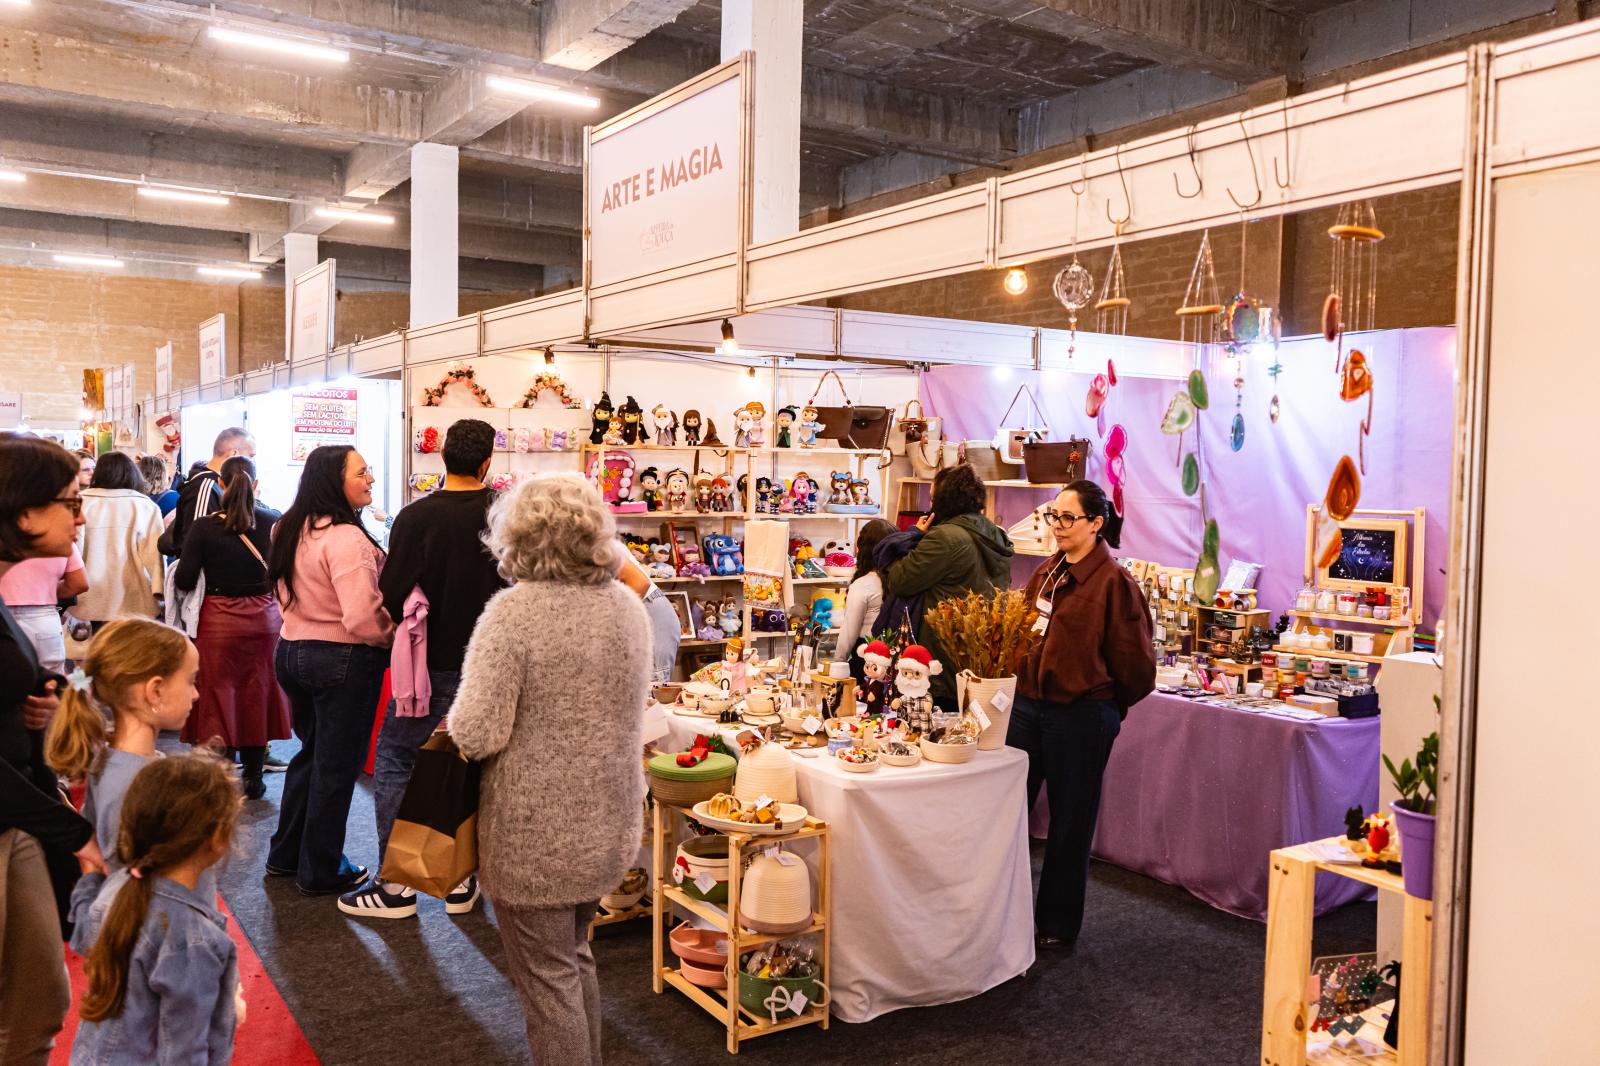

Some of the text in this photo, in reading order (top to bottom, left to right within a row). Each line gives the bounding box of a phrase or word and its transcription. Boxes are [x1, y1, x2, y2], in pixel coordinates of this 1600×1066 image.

[601, 141, 723, 214] ARTE E MAGIA
[303, 389, 348, 399] ISCOITOS
